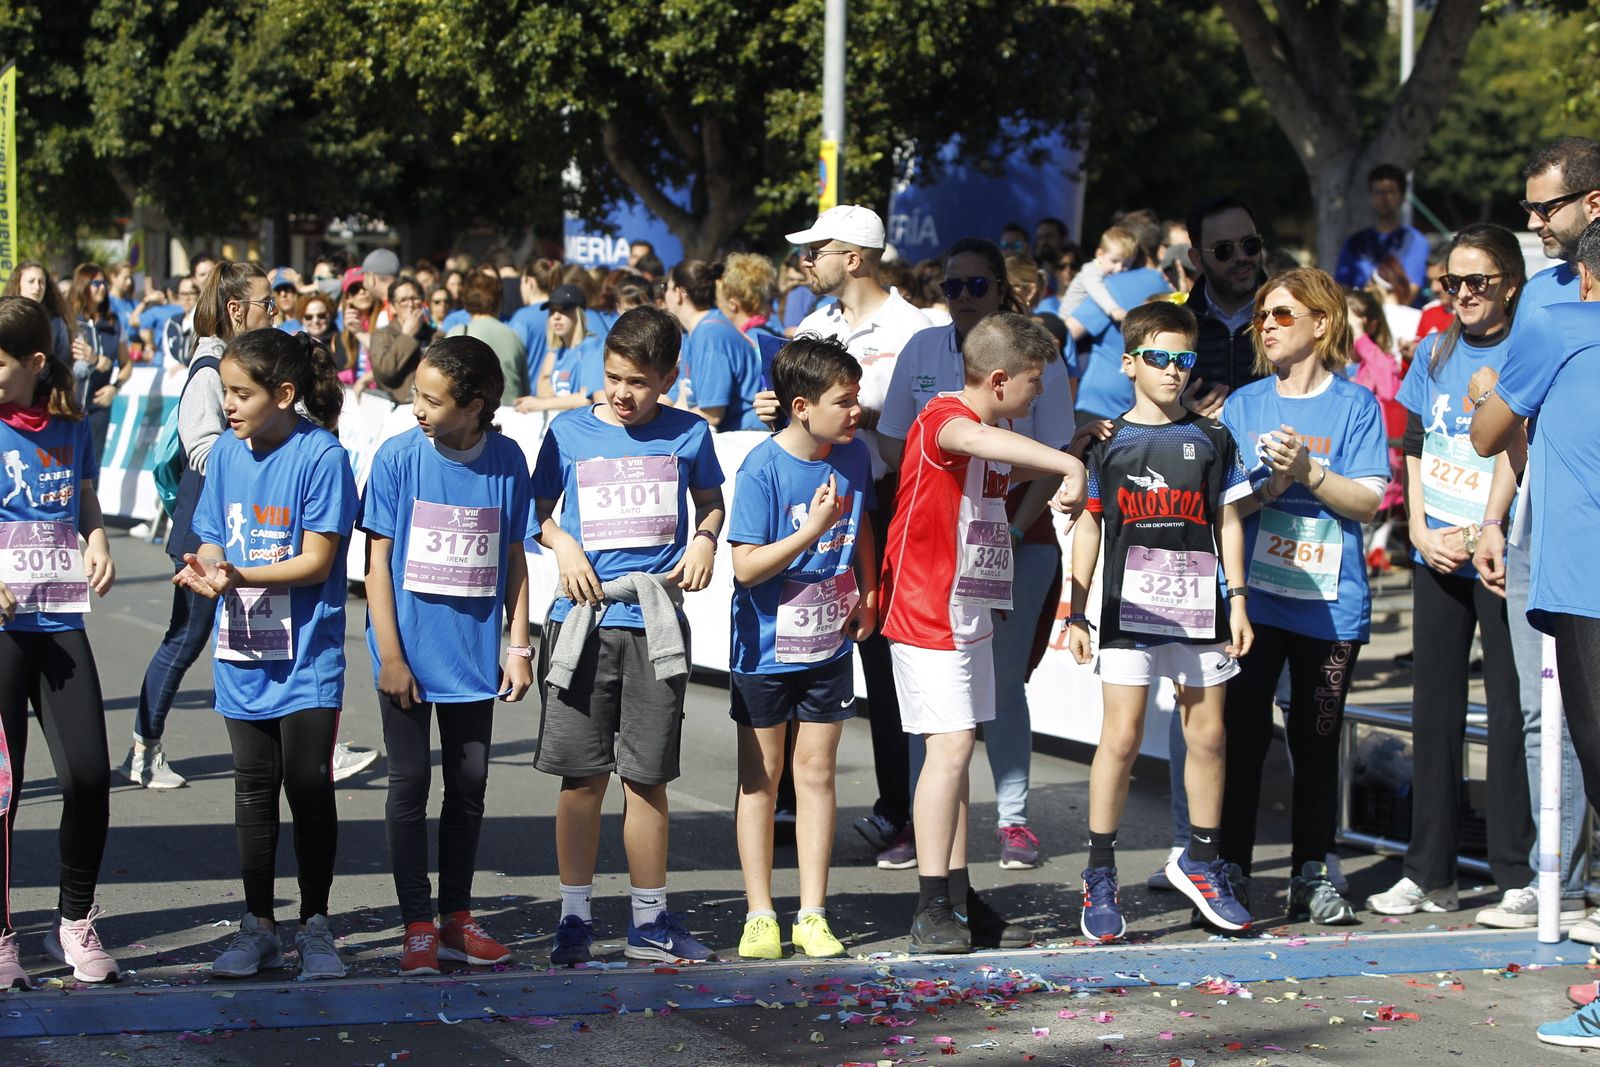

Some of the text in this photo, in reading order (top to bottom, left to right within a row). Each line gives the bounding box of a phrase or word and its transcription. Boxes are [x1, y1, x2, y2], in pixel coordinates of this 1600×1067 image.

[1430, 458, 1480, 490] 2274
[596, 483, 660, 508] 3101
[253, 504, 290, 527] VIII
[426, 531, 489, 556] 3178
[1267, 535, 1325, 563] 2261
[12, 549, 72, 571] 3019
[446, 556, 469, 564] IRENE
[975, 547, 1009, 570] 3248
[1139, 573, 1199, 598] 3231
[794, 596, 850, 628] 3195
[1151, 596, 1174, 604] SEBAS
[816, 624, 833, 632] PEPE
[1314, 639, 1353, 736] adida
